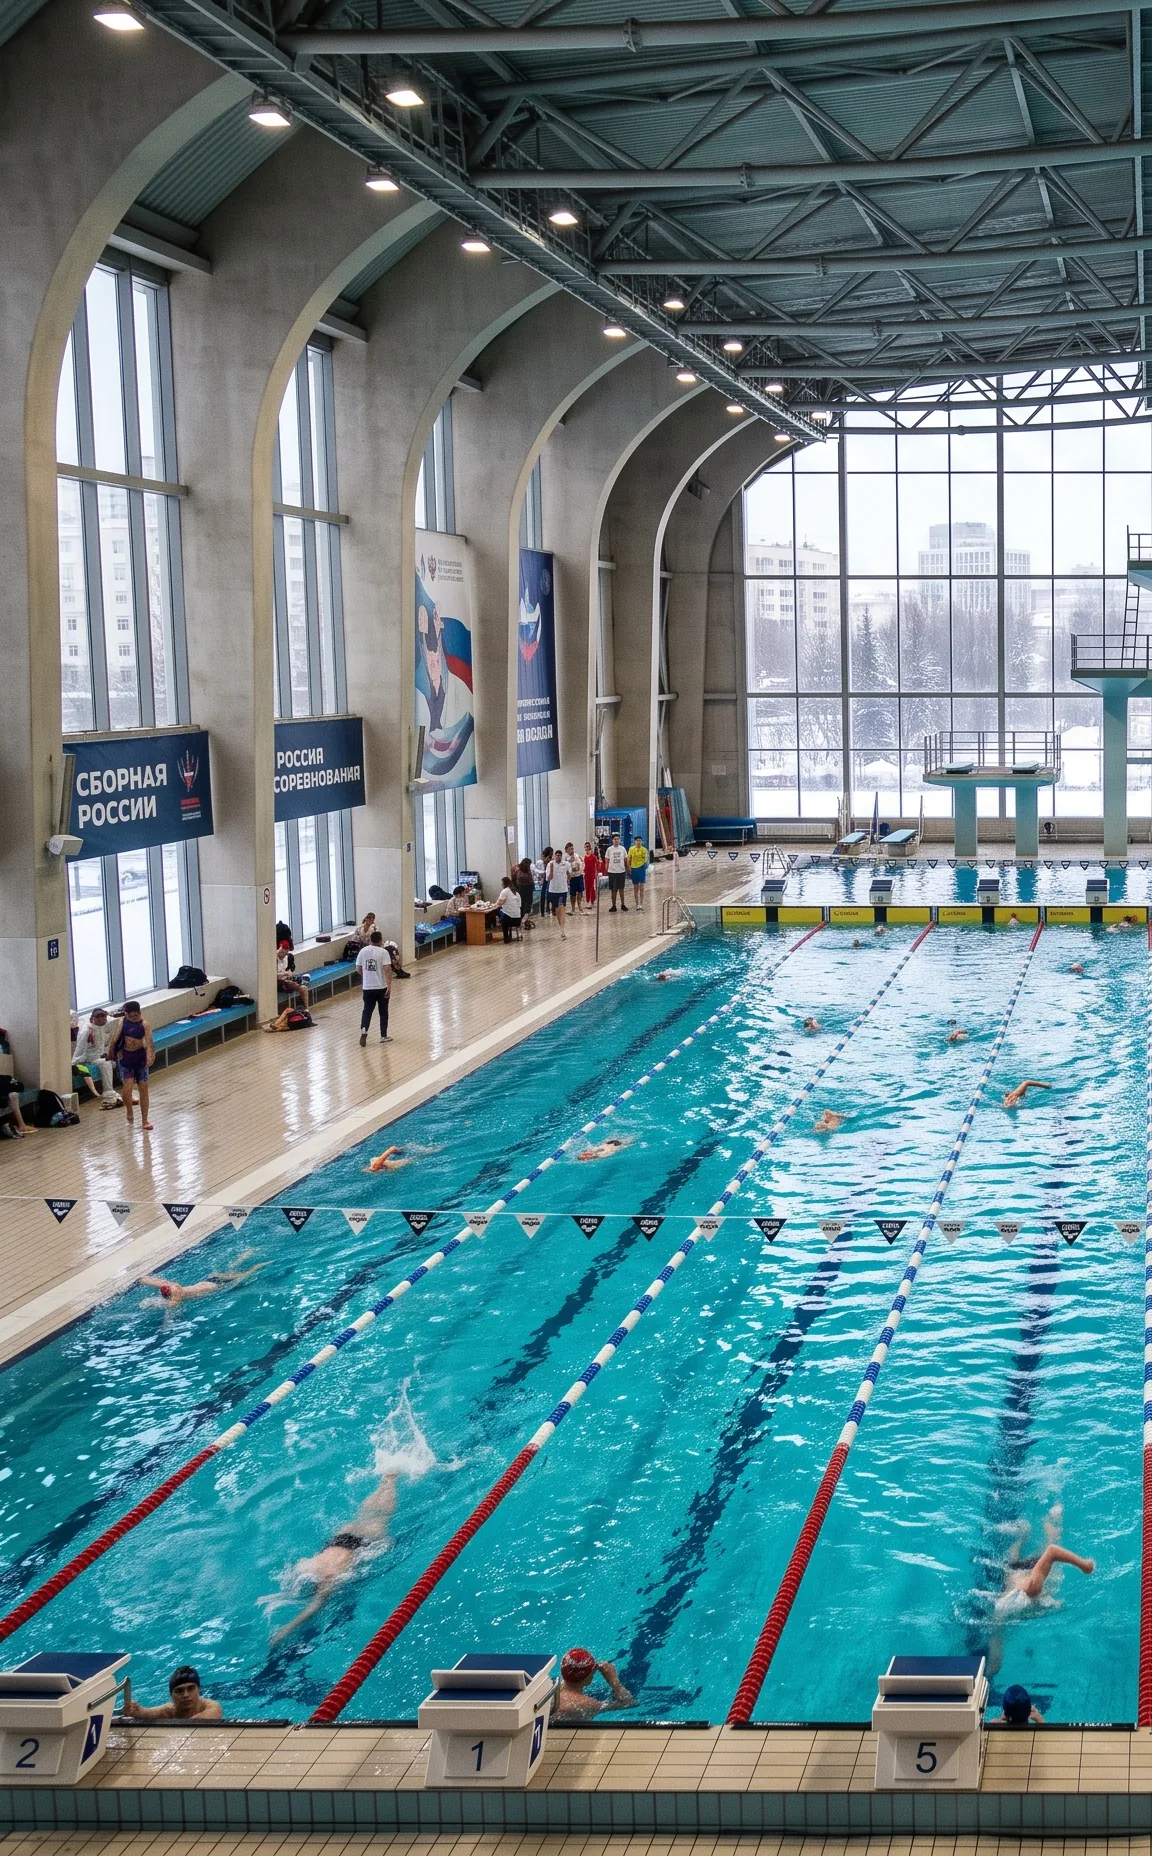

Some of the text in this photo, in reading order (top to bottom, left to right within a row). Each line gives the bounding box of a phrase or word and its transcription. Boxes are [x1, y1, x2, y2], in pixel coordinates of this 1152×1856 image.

[276, 747, 324, 769] РОССИЯ
[76, 763, 168, 797] СБОРНАЯ
[78, 795, 157, 829] РОССИИ
[15, 1738, 40, 1768] 2
[471, 1740, 484, 1772] 1
[915, 1742, 937, 1774] 5
